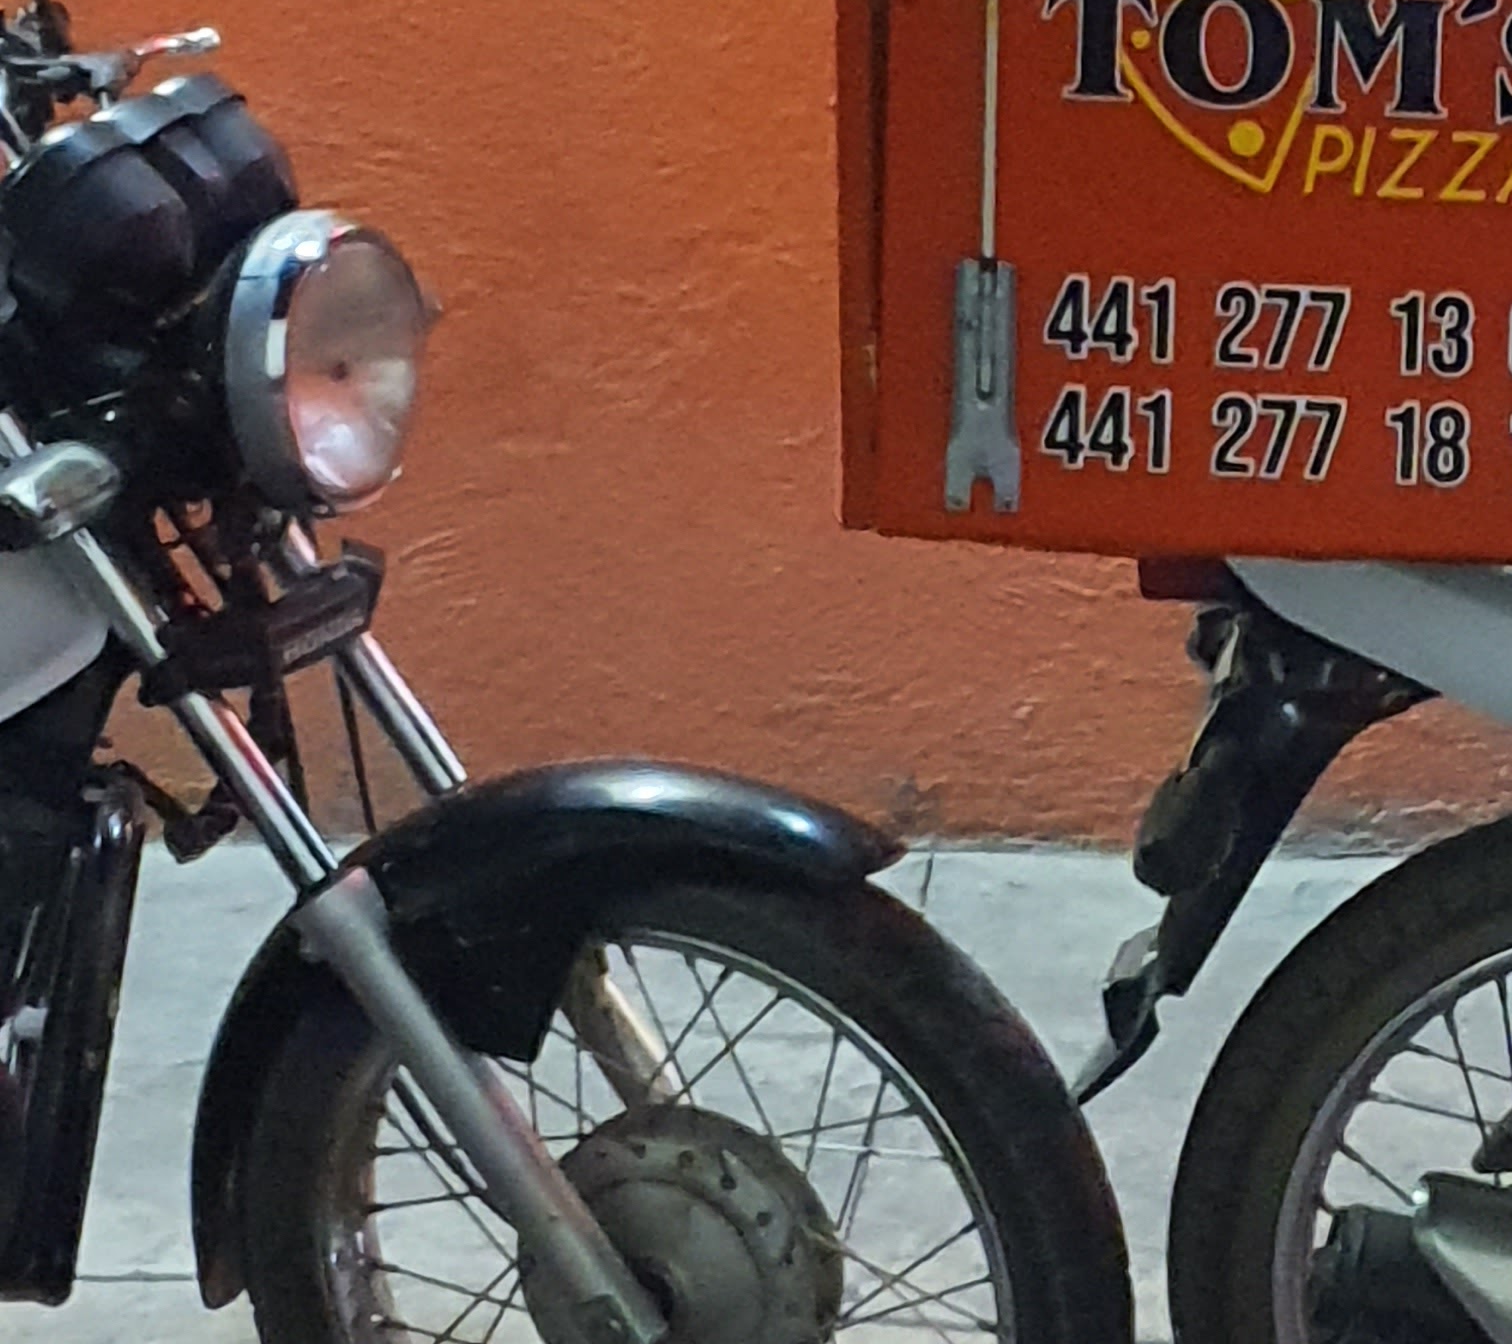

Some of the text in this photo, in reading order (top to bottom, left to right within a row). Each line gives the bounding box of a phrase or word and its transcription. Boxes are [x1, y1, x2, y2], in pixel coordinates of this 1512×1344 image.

[1043, 272, 1176, 364] 441
[1213, 281, 1351, 372] 277
[1391, 290, 1475, 378] 13
[1040, 383, 1173, 474] 441
[1210, 391, 1348, 482] 277
[1386, 400, 1471, 488] 18
